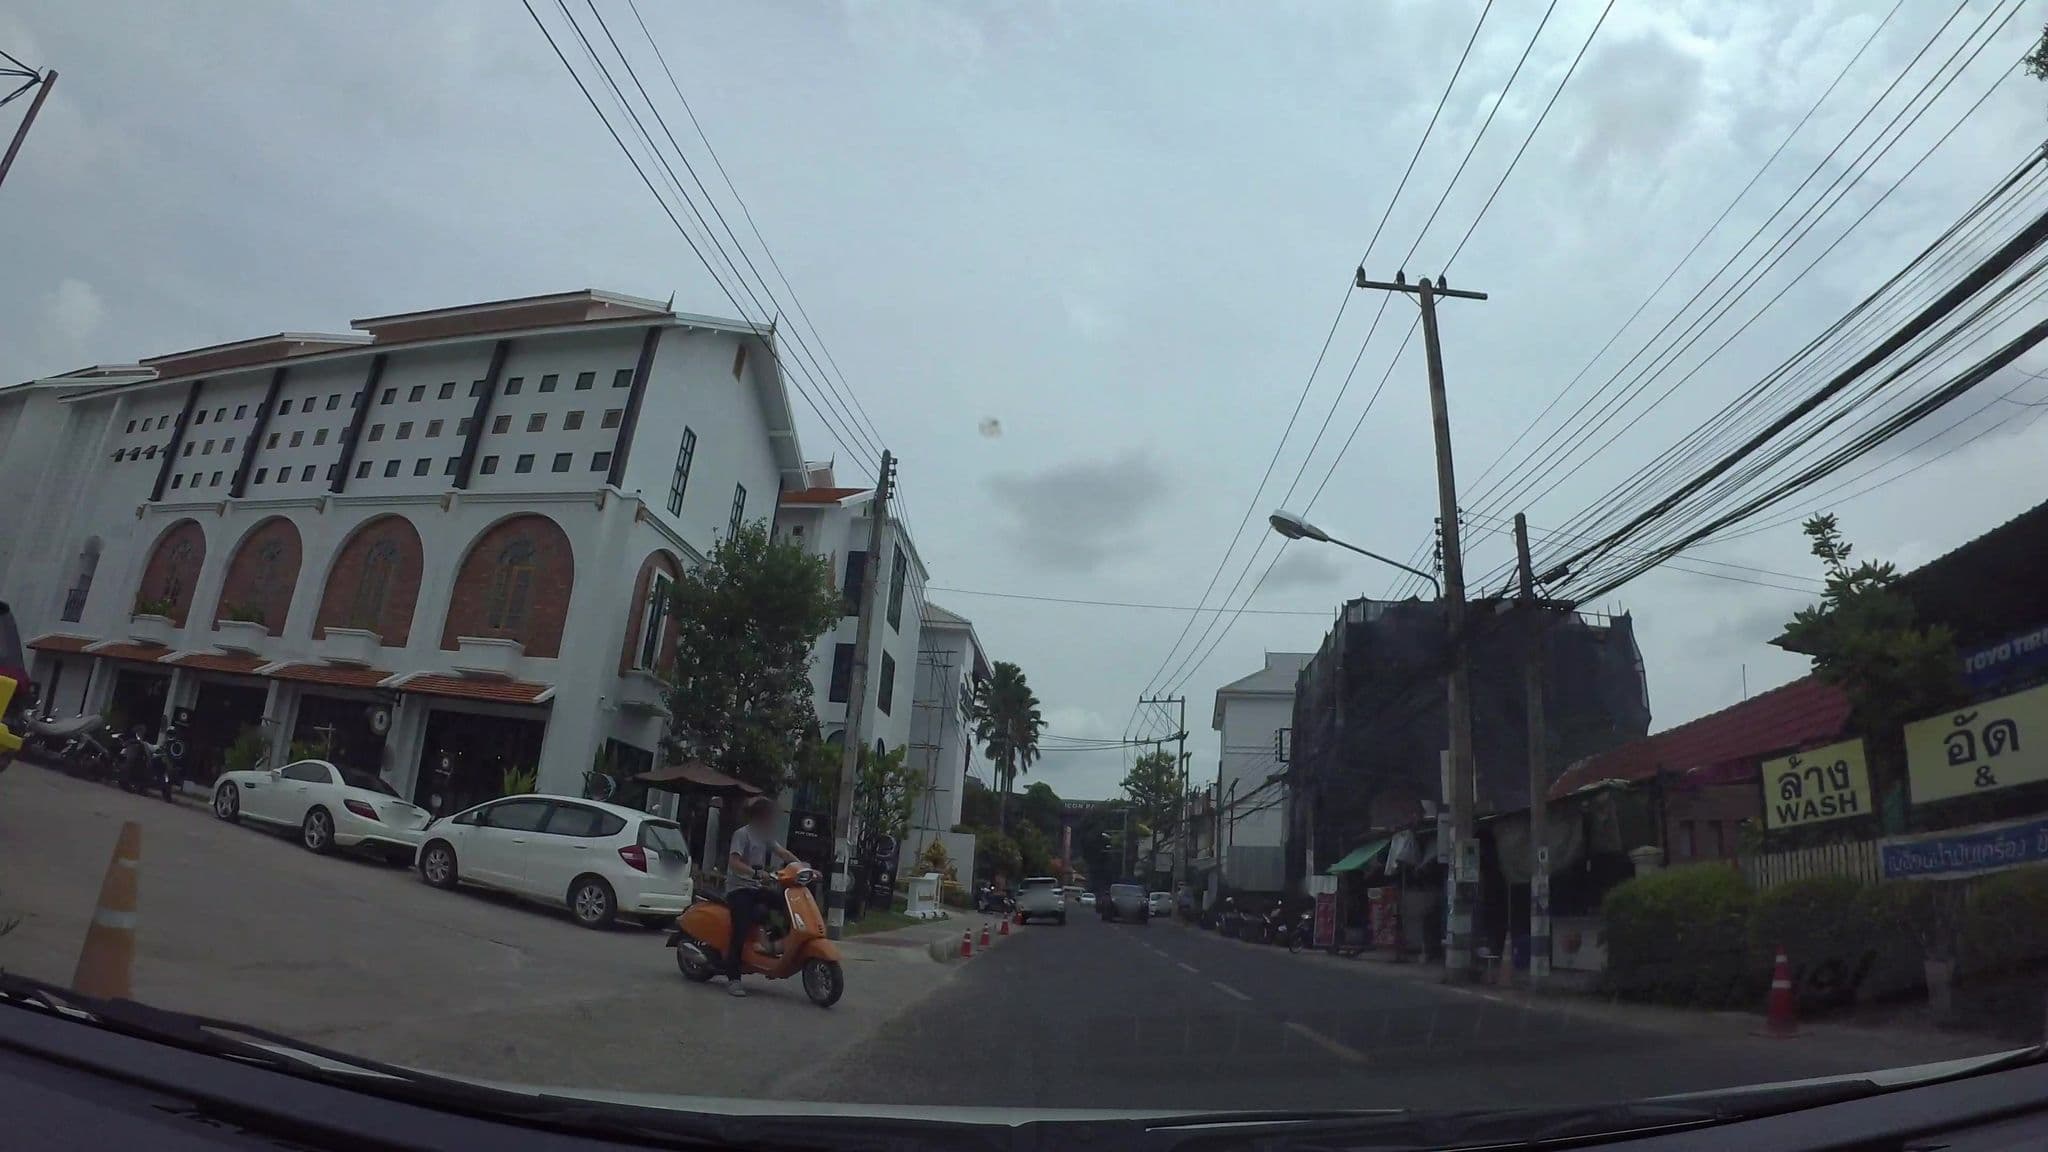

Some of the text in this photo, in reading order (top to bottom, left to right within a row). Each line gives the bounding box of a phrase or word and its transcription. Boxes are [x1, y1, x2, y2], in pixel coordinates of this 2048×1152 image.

[1965, 643, 2011, 674] TOYO
[1943, 711, 2020, 767] อัด
[1777, 755, 1850, 801] ล้าง
[1974, 765, 1998, 788] &
[1776, 790, 1858, 825] WASH
